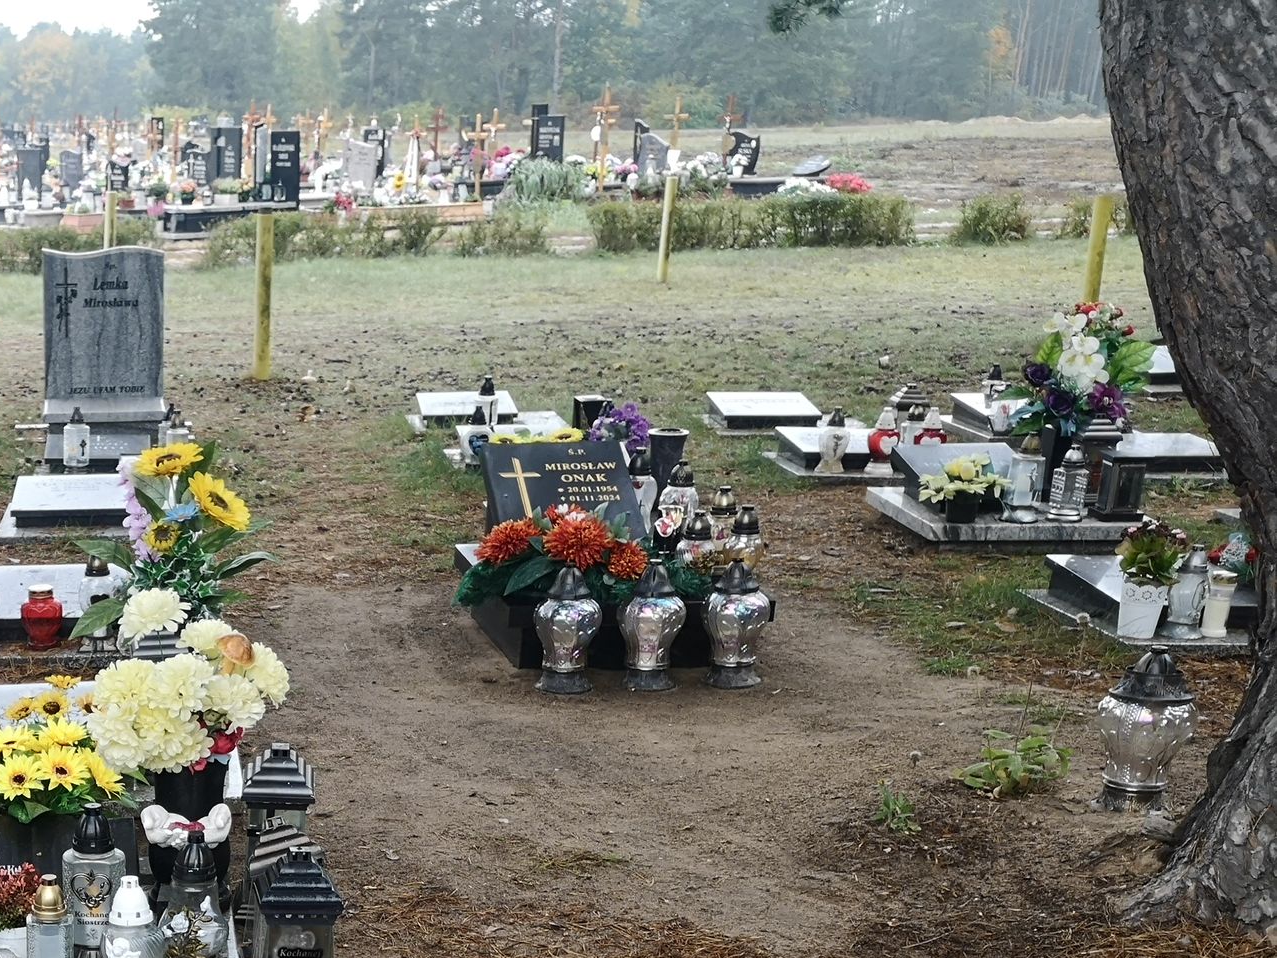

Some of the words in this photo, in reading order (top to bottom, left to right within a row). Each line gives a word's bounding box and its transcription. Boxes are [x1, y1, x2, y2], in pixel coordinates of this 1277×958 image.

[545, 462, 616, 471] MIROSŁAW
[561, 473, 608, 483] ONAK
[74, 911, 111, 919] Kochane
